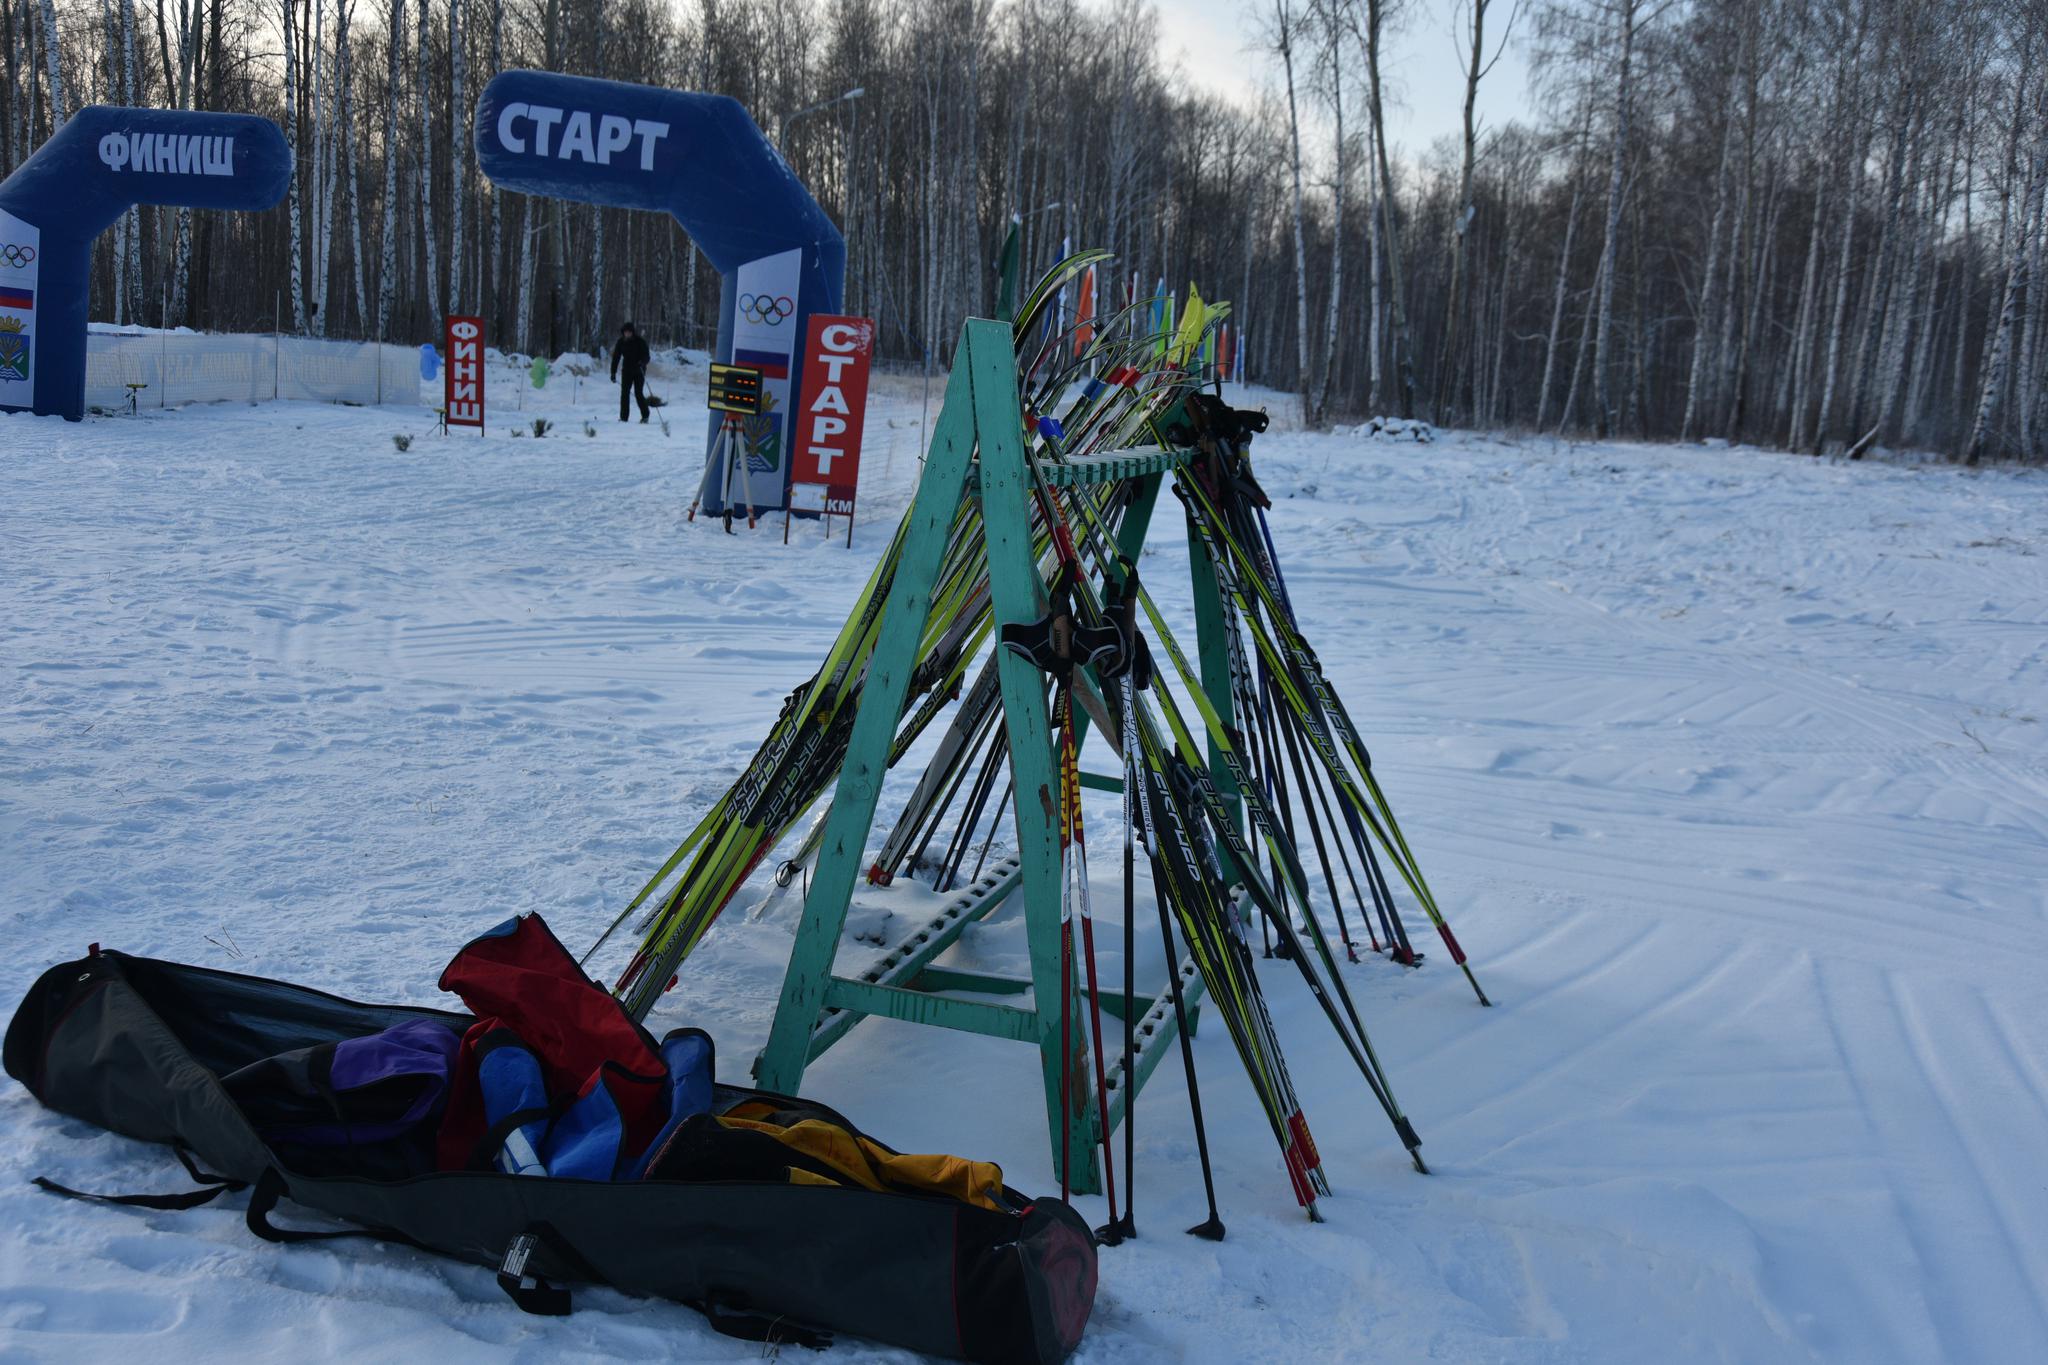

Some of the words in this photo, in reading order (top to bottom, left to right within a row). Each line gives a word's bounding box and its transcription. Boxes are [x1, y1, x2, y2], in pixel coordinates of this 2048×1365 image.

[98, 130, 235, 177] ФИНИШ
[497, 101, 671, 172] СТАРТ
[449, 320, 482, 421] ФИНИШ
[808, 323, 872, 475] СТАРТ
[893, 681, 945, 748] FISCHER
[1291, 648, 1354, 745] FISCHER
[739, 719, 798, 823] FISCHER
[763, 728, 821, 827] FISCHER
[1302, 711, 1352, 783] FISCHER
[1194, 765, 1246, 852] FISCHER
[1220, 750, 1274, 837] FISCHER
